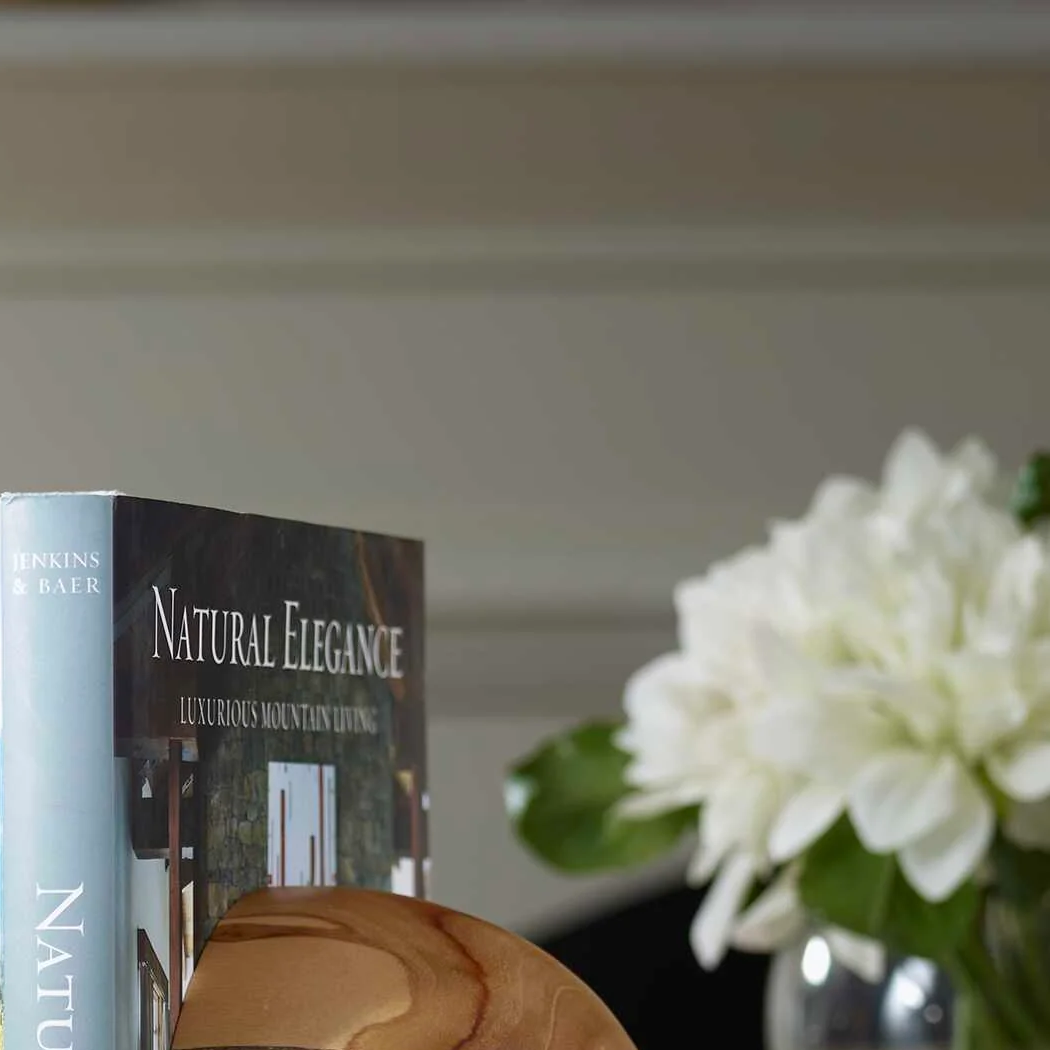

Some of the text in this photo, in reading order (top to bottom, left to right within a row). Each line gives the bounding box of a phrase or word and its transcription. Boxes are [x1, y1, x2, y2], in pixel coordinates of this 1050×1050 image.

[12, 551, 100, 571] JENKINS
[12, 577, 101, 596] & BAER
[152, 585, 405, 680] NATURAL ELEGANCE
[180, 696, 378, 734] LUXURIOUS MOUNTAIN LIVING
